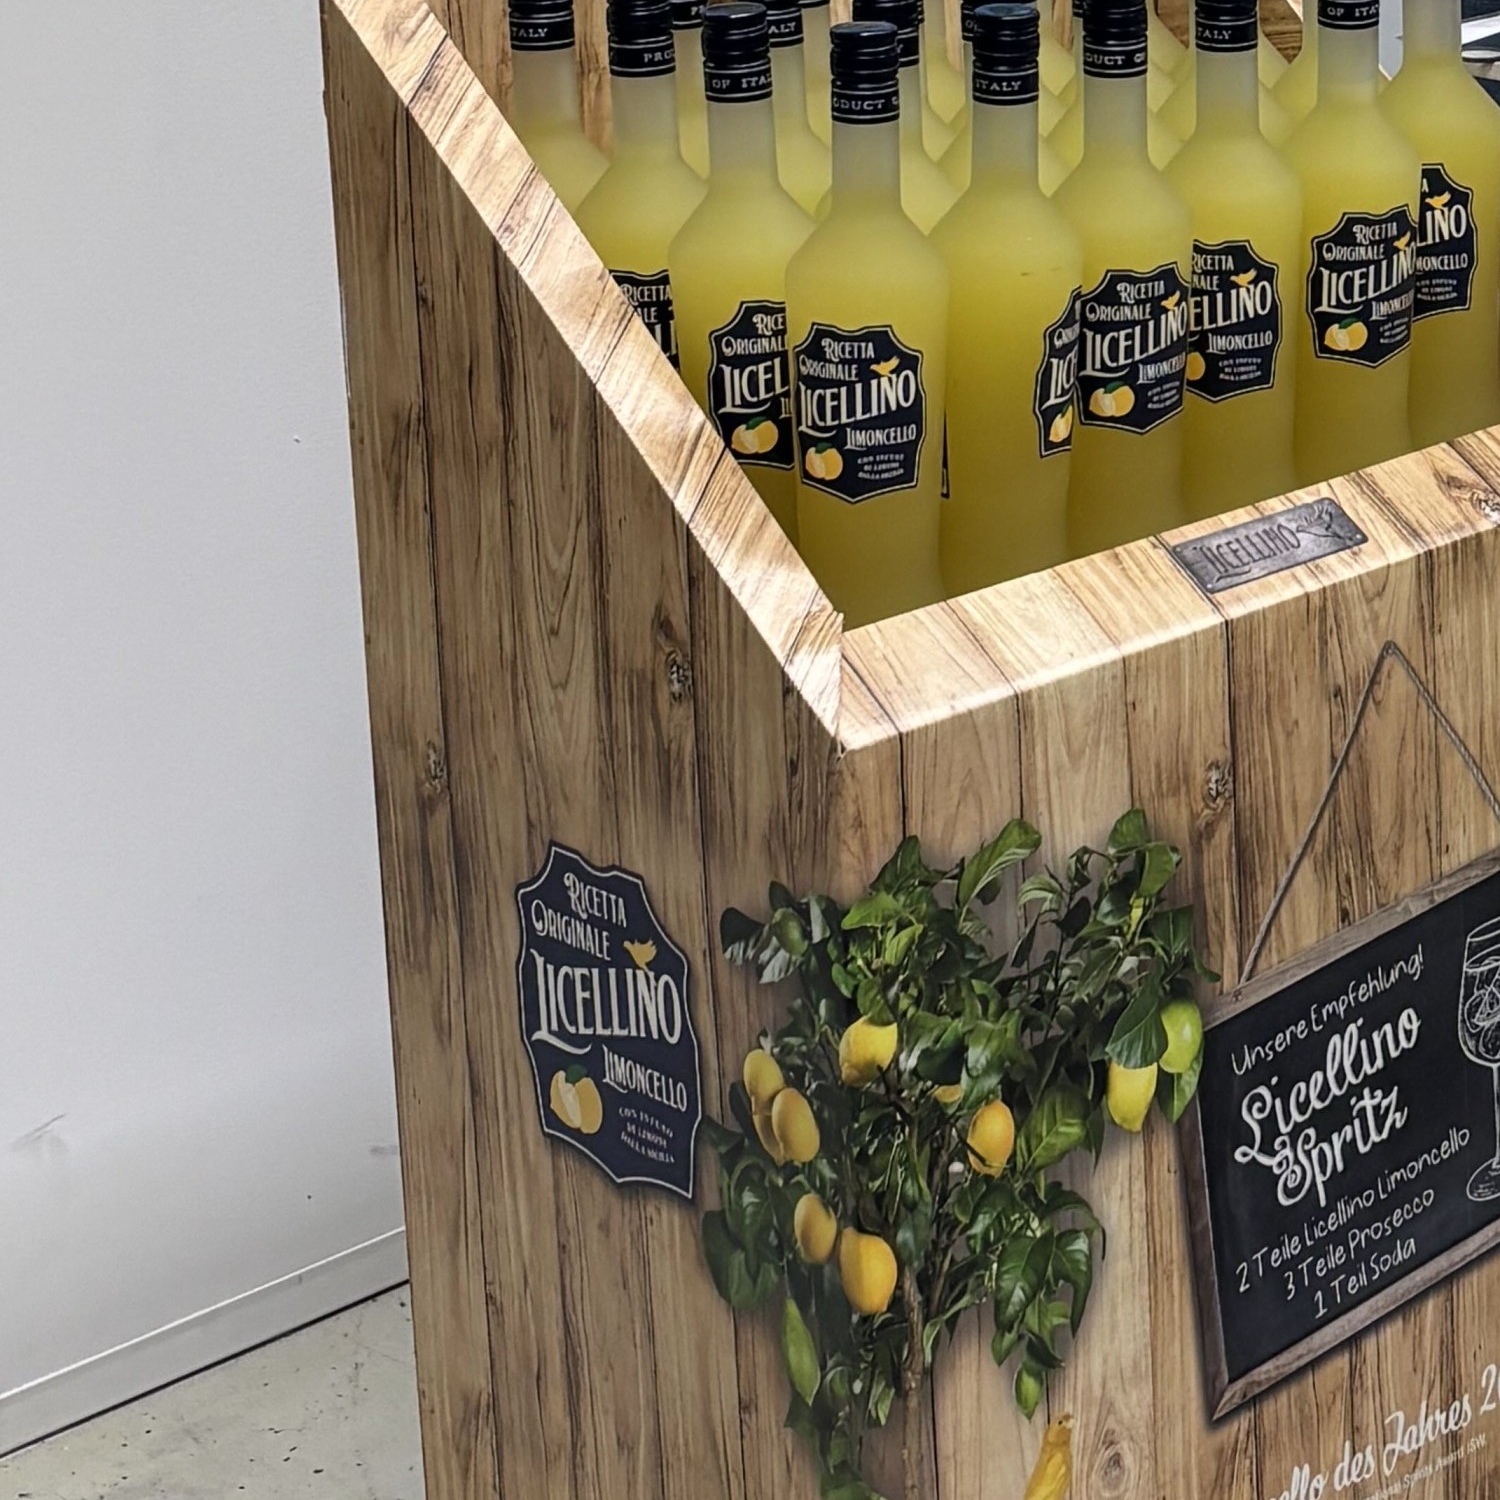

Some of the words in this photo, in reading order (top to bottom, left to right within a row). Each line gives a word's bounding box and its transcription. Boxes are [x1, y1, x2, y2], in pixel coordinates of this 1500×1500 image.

[511, 27, 548, 38] TALY
[768, 21, 796, 35] ALY
[1197, 27, 1232, 40] TALY
[1085, 53, 1126, 65] DUCT
[712, 78, 731, 90] OF
[975, 78, 1022, 92] ITALY
[833, 97, 886, 111] ODUCT
[1352, 221, 1398, 244] RICETTA
[1322, 242, 1385, 261] ORIGINALE
[1416, 252, 1468, 271] MONCELLO
[1116, 279, 1165, 303] RICETTA
[1085, 301, 1152, 322] ORIGINALE
[1189, 280, 1273, 333] ELLINO
[752, 312, 785, 335] RICE
[721, 335, 785, 356] ORIGINAL
[821, 337, 875, 362] RICETTA
[1079, 301, 1188, 378] LICELLINO
[1206, 329, 1273, 355] LIMONCELLO
[799, 354, 859, 381] ORIGINALE
[718, 357, 789, 414] LICEL
[798, 369, 917, 438] LICELLINO
[843, 423, 917, 451] LIMONCELLO
[1192, 522, 1302, 583] LICELLINO
[563, 871, 628, 928] RICETTA
[531, 899, 612, 962] ORIGINALE
[529, 947, 683, 1055] LICELLINO
[1231, 1019, 1309, 1076] Unsere
[1310, 943, 1425, 1032] Empfehlung!
[602, 1043, 688, 1113] LIMONCELLO
[1234, 1007, 1422, 1167] Licellino
[1272, 1086, 1408, 1208] Spritz
[1236, 1262, 1251, 1293] 2
[1252, 1234, 1302, 1278] Teile
[1303, 1189, 1375, 1247] Licellino
[1378, 1126, 1471, 1200] Limoncello
[1283, 1271, 1296, 1301] 3
[1298, 1244, 1347, 1287] Teile
[1348, 1188, 1435, 1259] Prosecco
[1315, 1290, 1328, 1319] 1
[1330, 1264, 1368, 1304] Teil
[1371, 1237, 1416, 1281] Soda
[1333, 1440, 1375, 1492] des
[1383, 1394, 1473, 1475] Jahres
